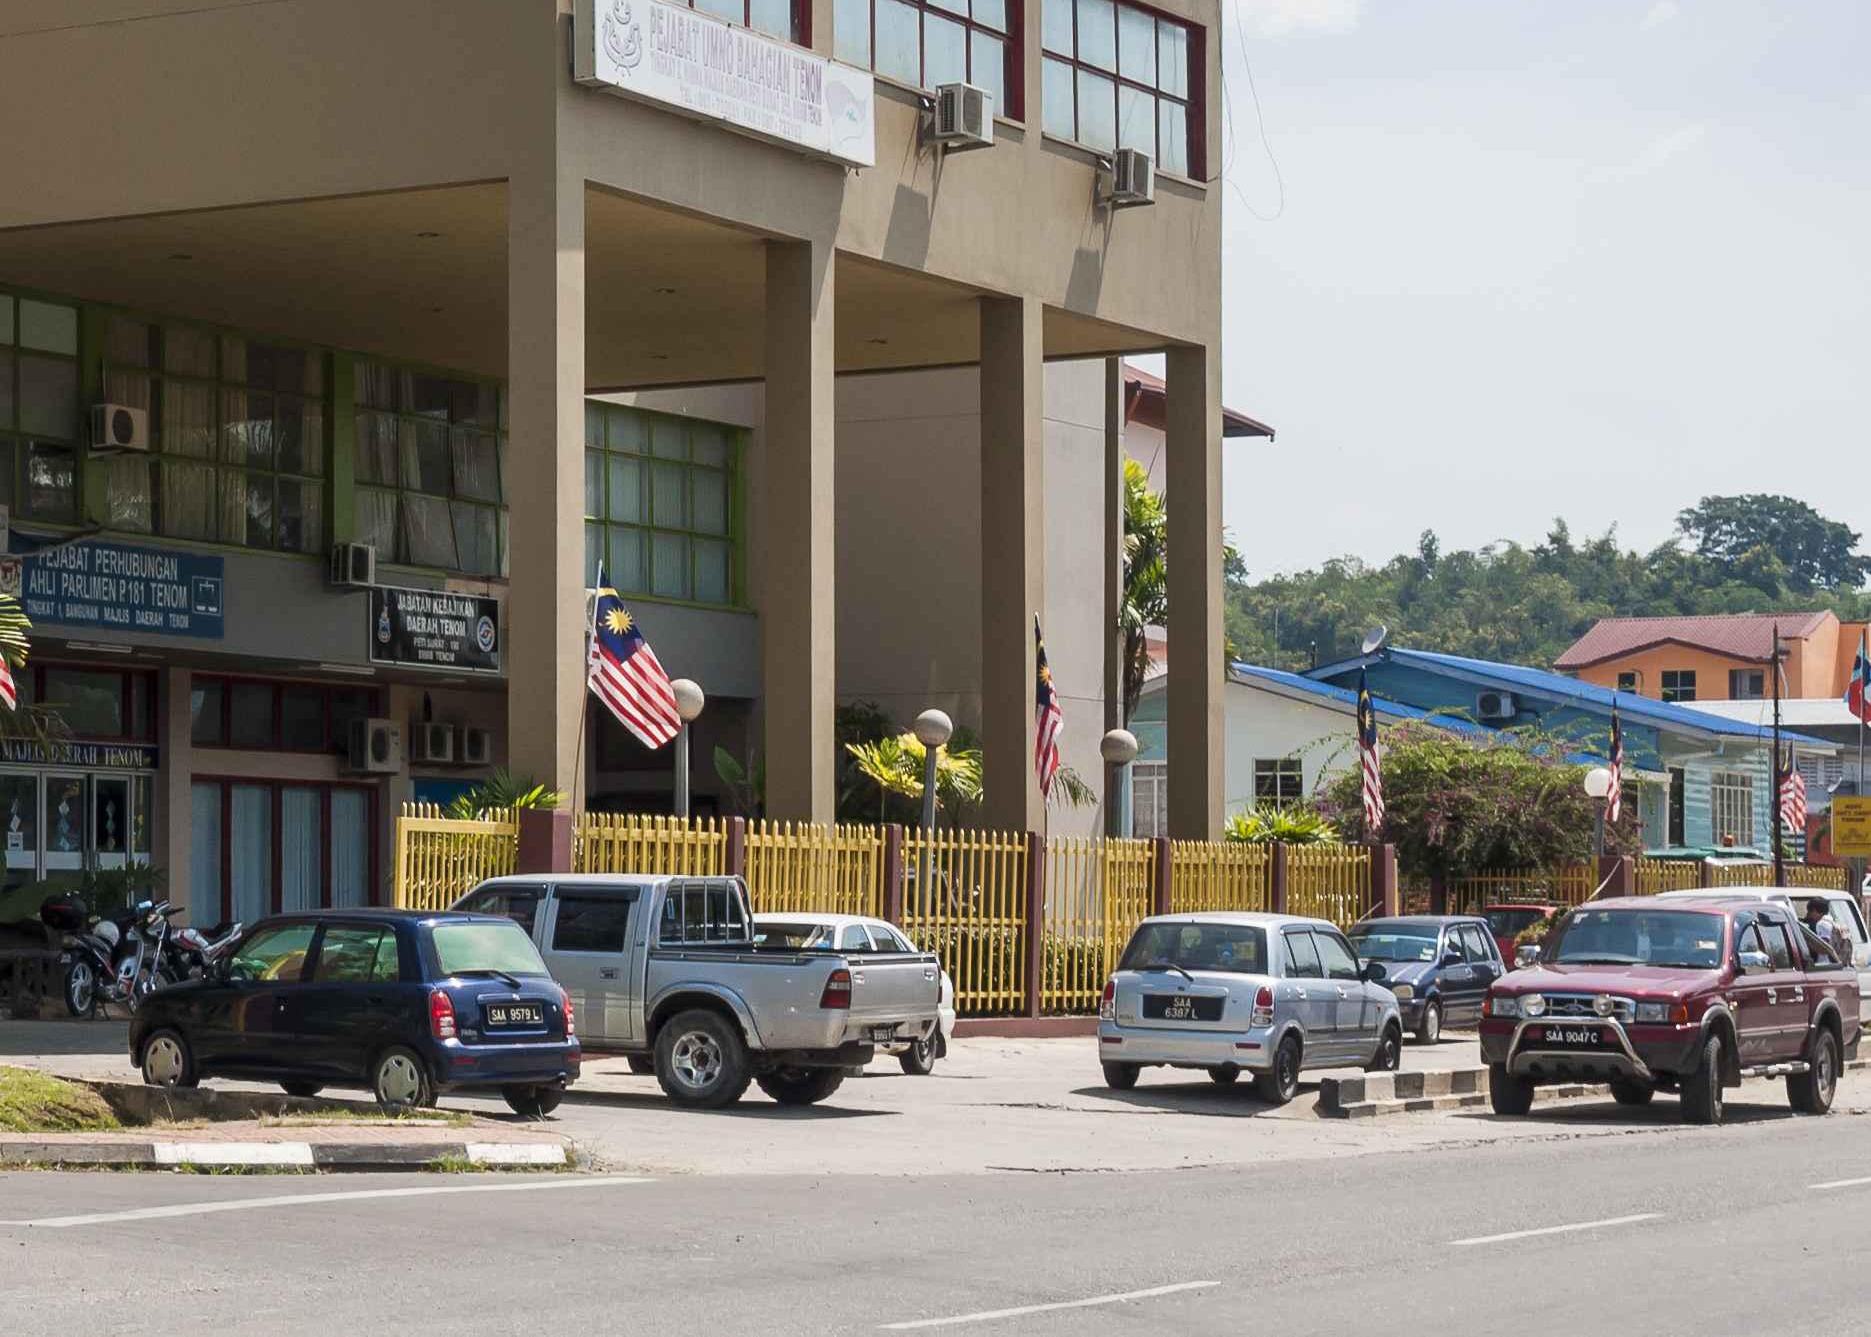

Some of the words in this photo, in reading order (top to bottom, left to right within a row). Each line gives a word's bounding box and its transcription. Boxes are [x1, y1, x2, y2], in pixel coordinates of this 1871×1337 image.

[650, 6, 698, 63] PEJABAT
[703, 25, 733, 74] UMNO
[737, 37, 789, 93] BAHAGIAN
[794, 57, 821, 104] TENOM
[39, 546, 90, 572] PEJABAT
[96, 549, 178, 580] PERHUBUNGAN
[29, 569, 56, 595] AHLI
[61, 573, 116, 602] PARLIMEN
[150, 582, 188, 609] TENOM
[27, 599, 54, 616] TINGKAT
[104, 607, 130, 623] MAJLIS
[135, 609, 164, 627] DAERAH
[169, 613, 189, 629] TENOM
[397, 594, 431, 613] JABATAN
[432, 598, 475, 618] KEBAJIKAN
[406, 615, 438, 634] DAERAH
[440, 619, 466, 637] TENOM
[103, 747, 143, 767] TENOM
[1165, 1007, 1189, 1018] 6387
[1173, 997, 1191, 1008] SAA
[491, 1008, 507, 1021] SAA
[510, 1008, 531, 1021] 9579
[1545, 1030, 1564, 1042] SAA
[1566, 1031, 1590, 1043] 9047
[1590, 1032, 1598, 1044] C
